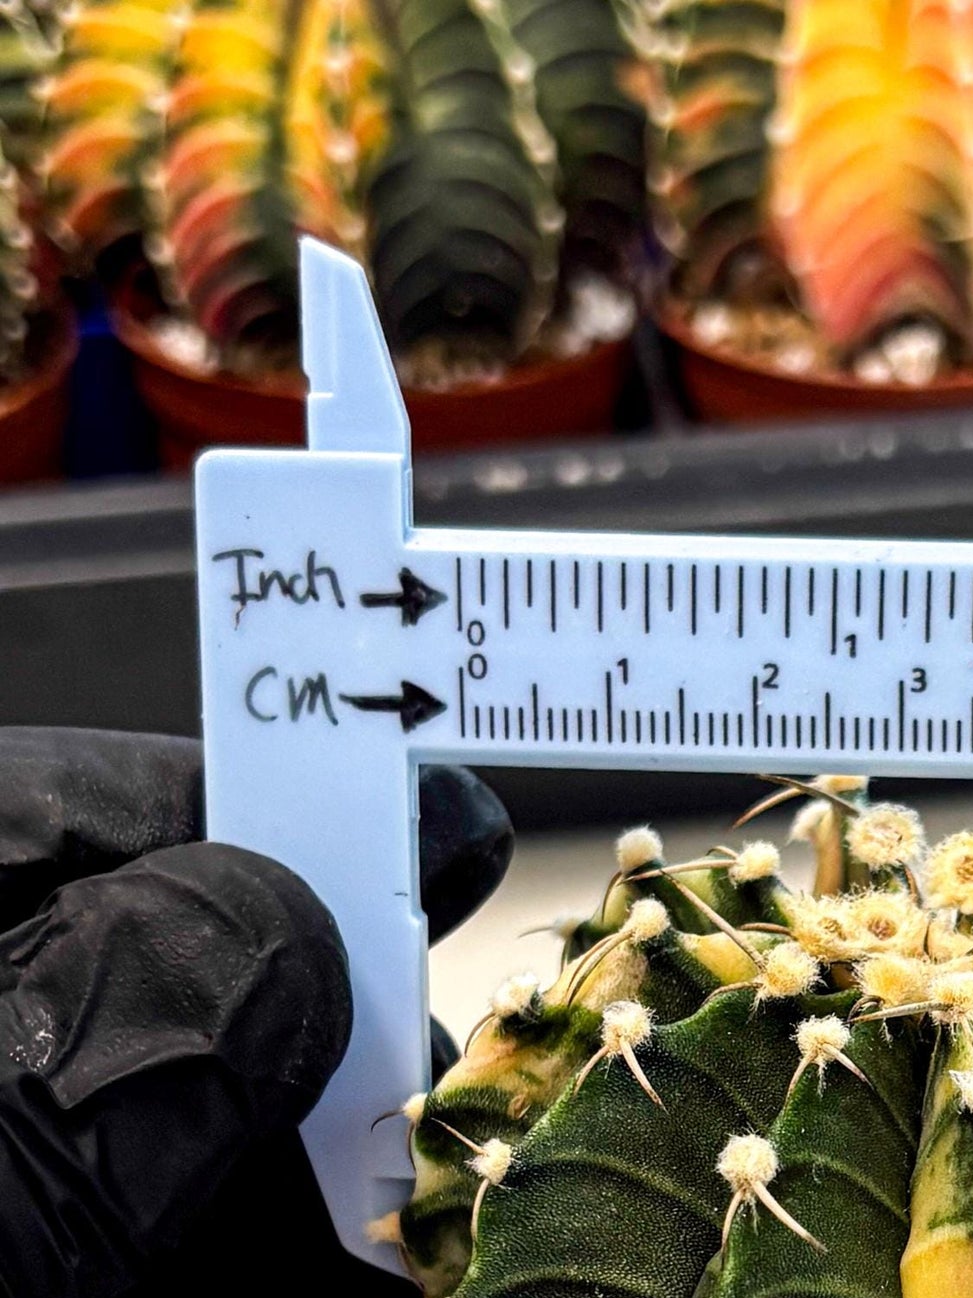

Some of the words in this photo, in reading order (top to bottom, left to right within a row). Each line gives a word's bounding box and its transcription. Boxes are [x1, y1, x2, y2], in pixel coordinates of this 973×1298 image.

[213, 548, 345, 609] Inch
[467, 620, 485, 646] 0
[843, 634, 857, 659] 1
[468, 654, 488, 679] 0
[616, 658, 629, 684] 1
[761, 663, 779, 689] 2
[909, 668, 928, 693] 3
